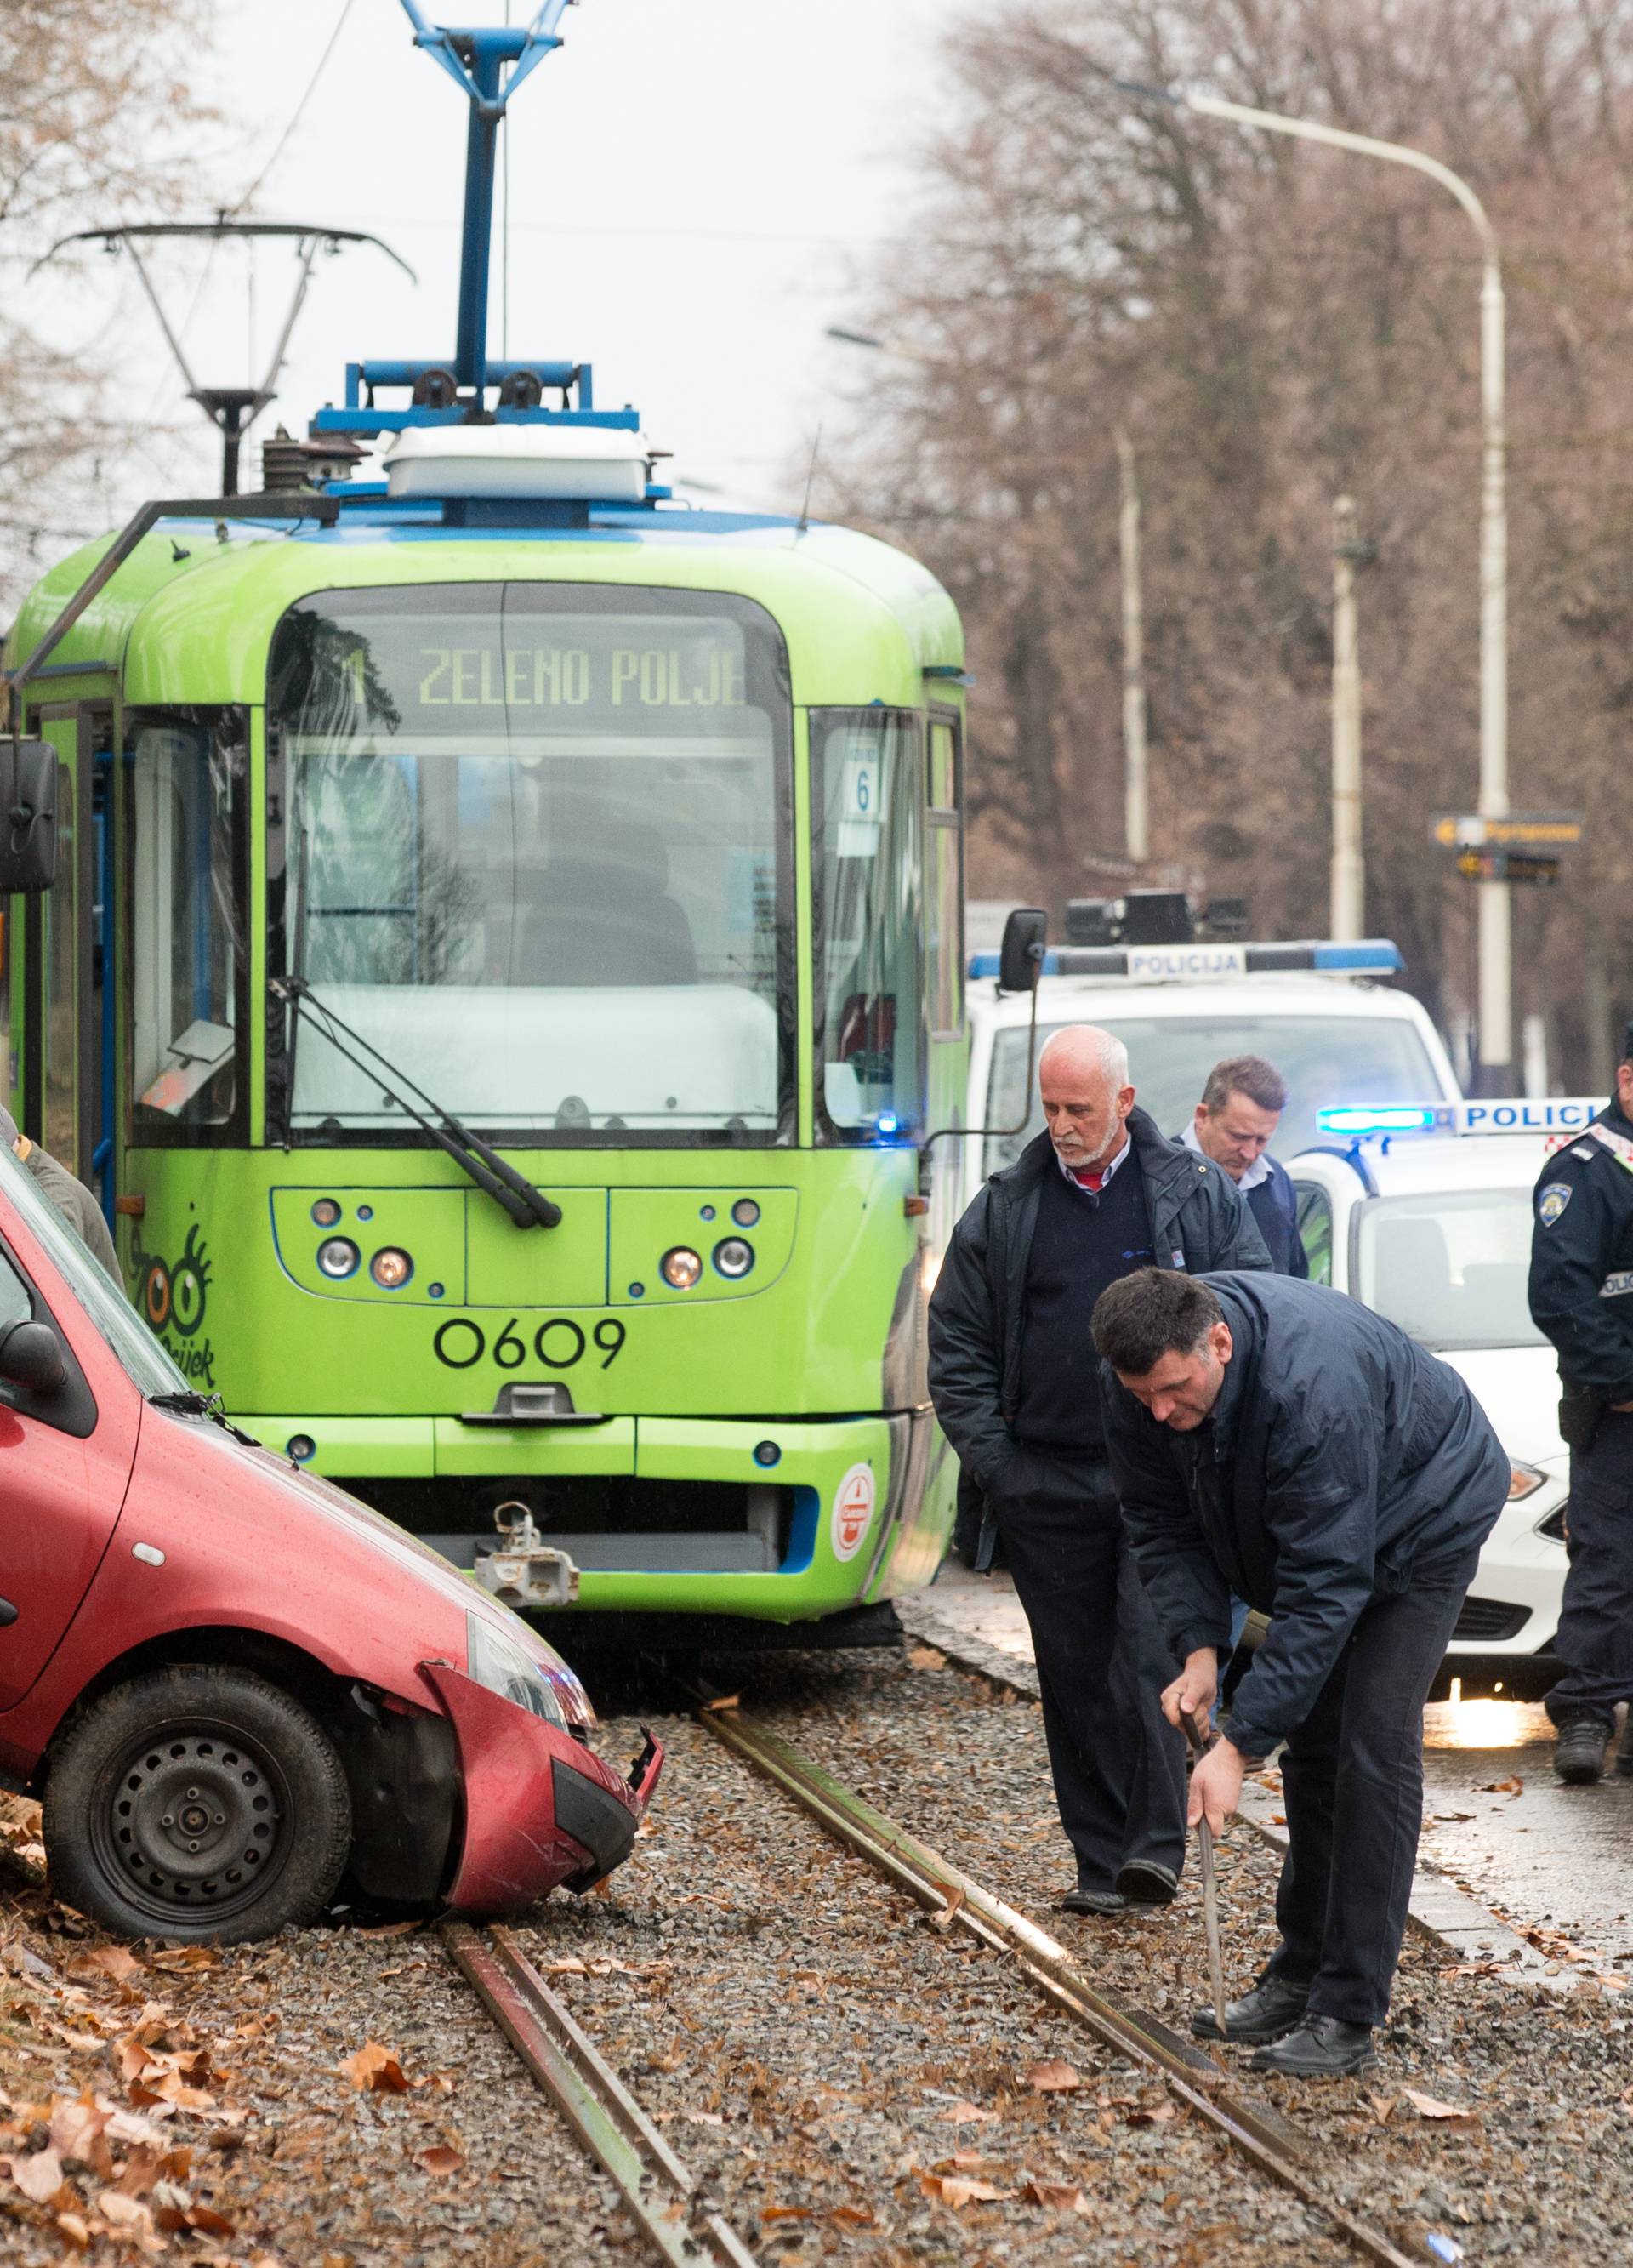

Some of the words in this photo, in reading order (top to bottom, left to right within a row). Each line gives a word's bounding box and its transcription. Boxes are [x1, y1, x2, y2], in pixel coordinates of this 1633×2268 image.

[420, 650, 590, 704] ZELENO
[612, 650, 747, 705] POLJE
[857, 770, 869, 811] 6
[1132, 954, 1238, 973] POLICIJA
[434, 1318, 626, 1370] 0609
